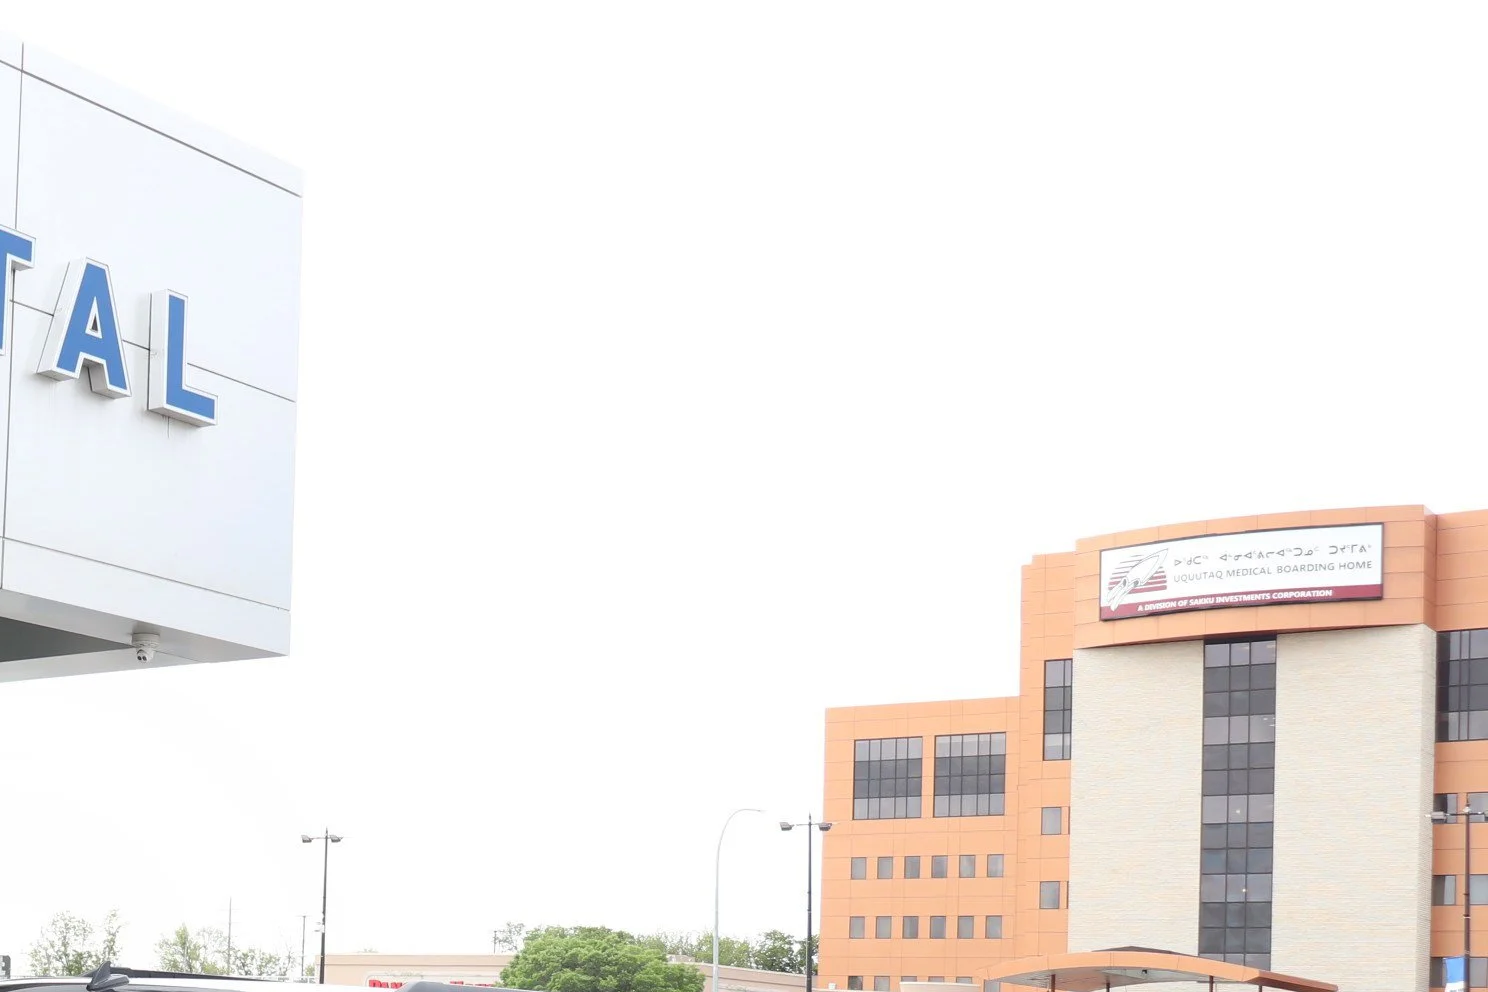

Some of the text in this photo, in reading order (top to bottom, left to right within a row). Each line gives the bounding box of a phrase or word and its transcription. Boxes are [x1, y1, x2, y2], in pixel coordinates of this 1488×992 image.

[1173, 560, 1373, 583] UQUUTAQ MEDICAL BOARDING HOME
[1137, 589, 1333, 612] A DIVISION OF SAKKU INVESTMENTS CORPORATION
